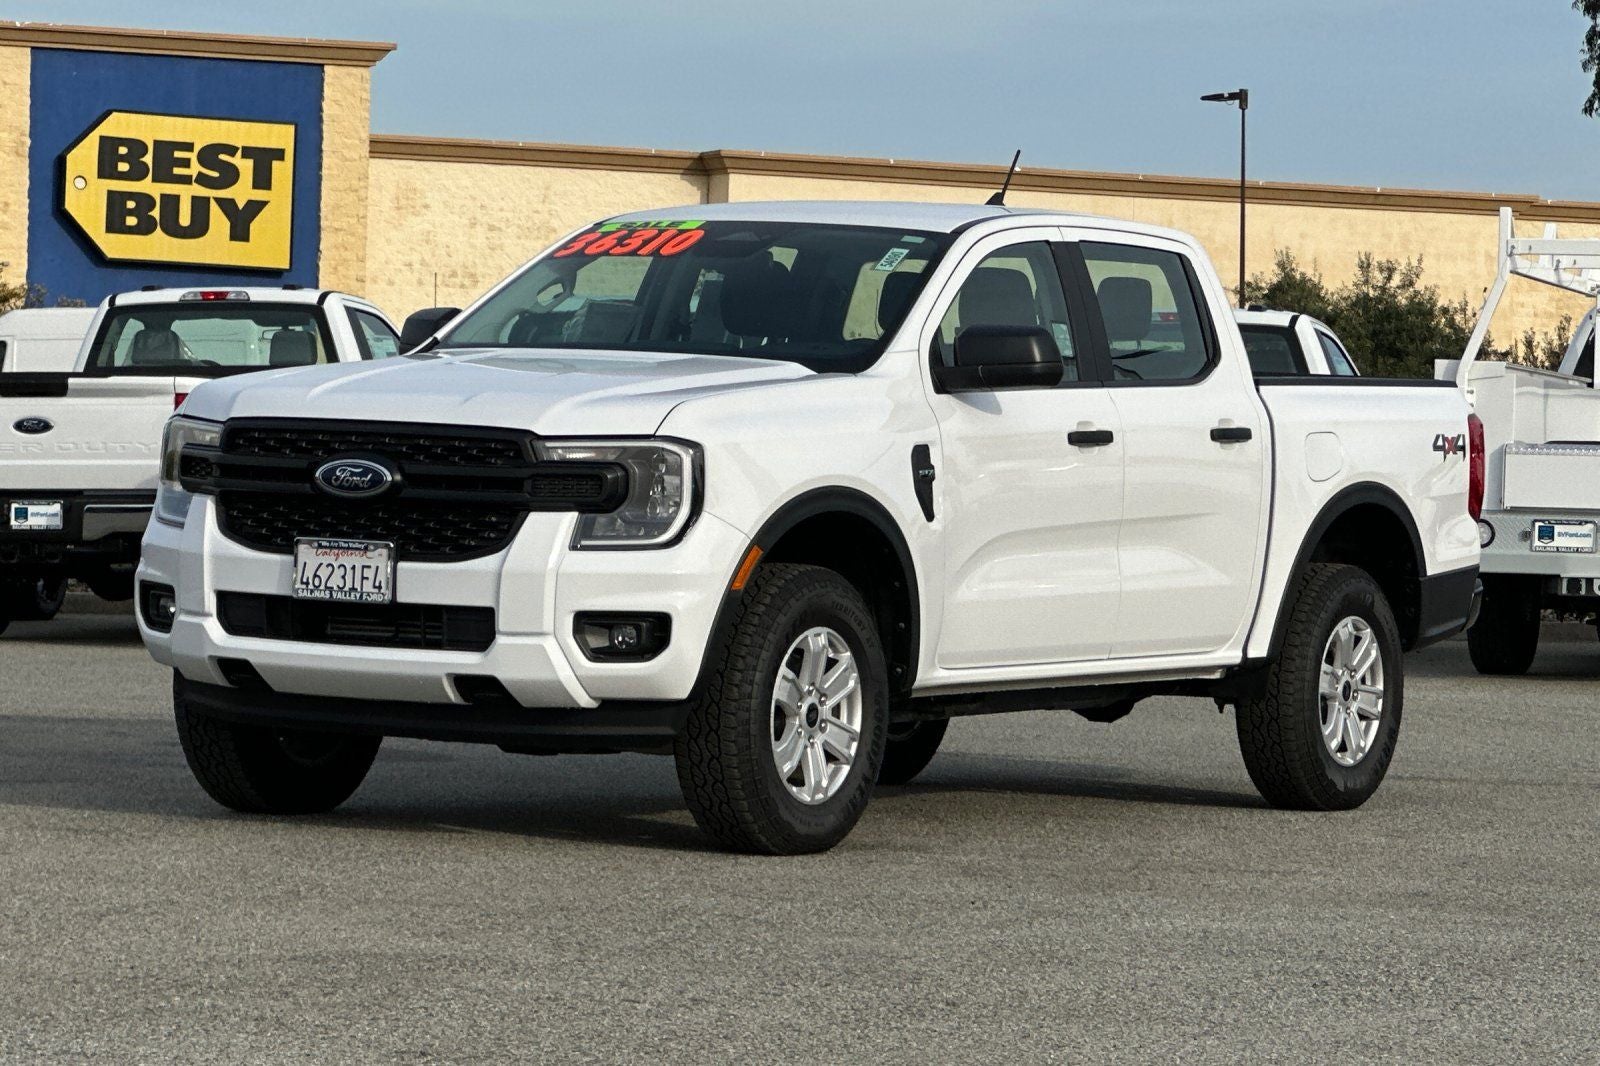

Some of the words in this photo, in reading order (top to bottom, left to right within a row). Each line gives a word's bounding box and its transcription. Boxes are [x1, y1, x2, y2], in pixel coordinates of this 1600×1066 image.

[97, 135, 286, 191] BEST
[105, 190, 271, 243] BUY
[553, 229, 704, 257] 36310
[54, 441, 159, 454] DUTY
[331, 466, 373, 489] Ford
[300, 561, 383, 593] 46231F4
[332, 590, 361, 600] VALLEY
